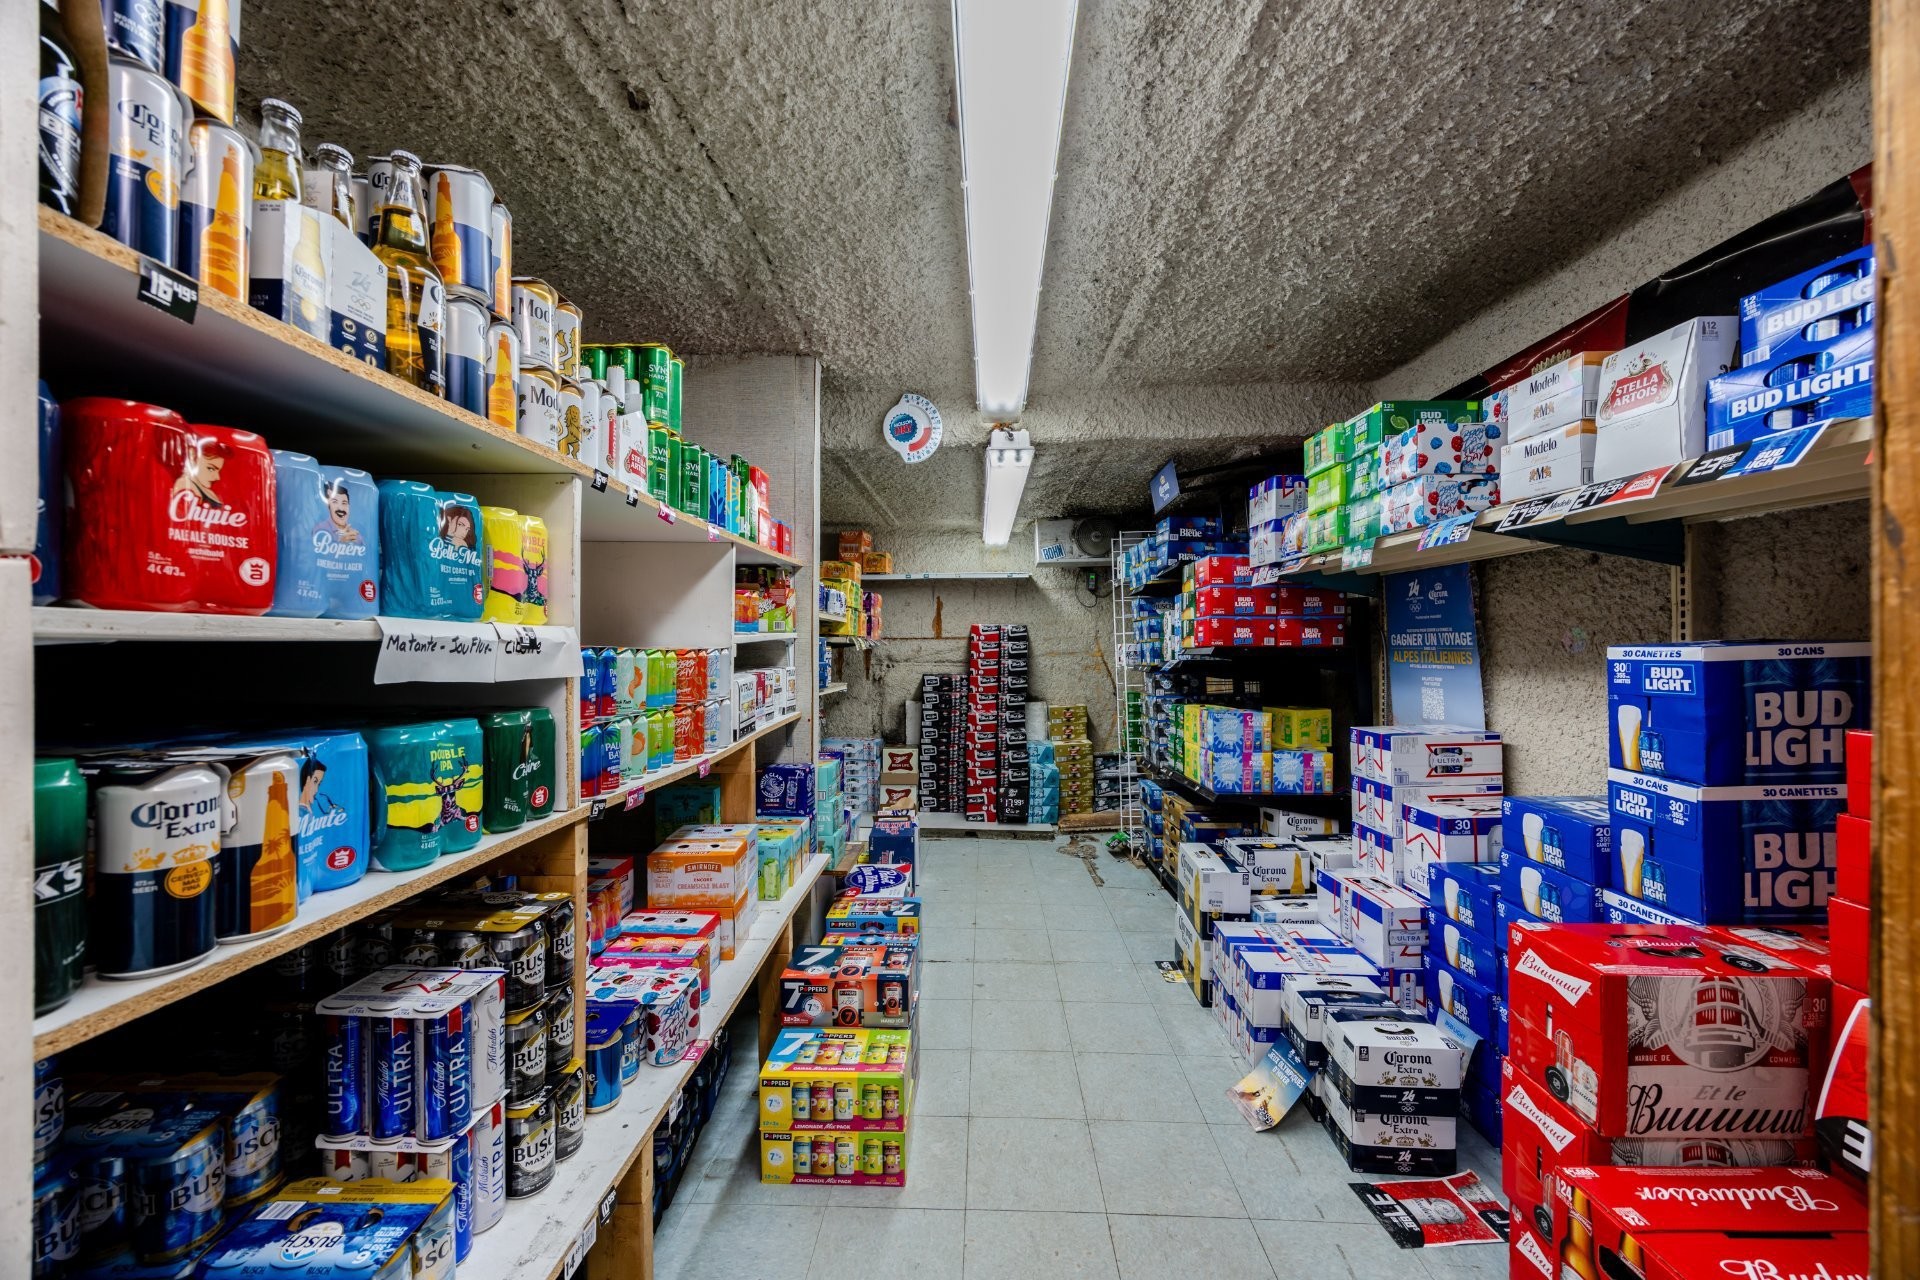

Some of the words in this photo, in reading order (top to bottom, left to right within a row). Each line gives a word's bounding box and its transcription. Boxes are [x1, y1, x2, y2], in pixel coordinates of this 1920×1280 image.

[1743, 295, 1757, 308] 12
[1767, 299, 1822, 332] BUD
[1826, 277, 1875, 306] LIG
[1707, 321, 1717, 330] 12
[1529, 372, 1560, 396] Modelo
[1615, 372, 1659, 398] STELLA
[1732, 388, 1783, 419] BUD
[1786, 359, 1875, 403] LIGHT
[1613, 386, 1658, 409] ARTOIS
[1420, 411, 1442, 420] BUD
[1524, 438, 1557, 459] Modelo
[1754, 447, 1786, 461] BUD
[1744, 456, 1784, 470] LIGHT
[1425, 475, 1435, 483] 12
[168, 490, 248, 529] Chipie
[168, 527, 188, 541] PALE
[189, 530, 207, 544] ALE
[208, 532, 249, 549] ROUSSE
[1179, 528, 1203, 538] Bleue
[428, 537, 459, 561] Belle
[1042, 543, 1066, 561] BOHN
[1391, 633, 1423, 646] GAGNER
[1424, 632, 1438, 646] UN
[1438, 631, 1474, 646] VOYAGE
[1393, 650, 1419, 663] ALPES
[1421, 650, 1473, 665] ITALIENNES
[1622, 650, 1633, 658] 30
[1634, 649, 1682, 658] CANETTES
[1778, 647, 1792, 657] 30
[1793, 647, 1825, 656] CANS
[1613, 662, 1626, 673] 30
[1650, 666, 1684, 680] BUD
[1645, 678, 1692, 692] LIGHT
[1754, 689, 1853, 728] BUD
[430, 747, 465, 762] DOUBLE
[1745, 728, 1845, 766] LIGH
[1641, 749, 1662, 761] BUD
[439, 759, 453, 772] IPA
[1641, 758, 1665, 771] LIGHT
[1633, 777, 1644, 787] 30
[1645, 779, 1669, 793] CANS
[1762, 788, 1776, 797] 30
[1778, 787, 1839, 797] CANETTES
[1620, 789, 1648, 807] BUD
[1616, 799, 1653, 820] LIGHT
[1669, 800, 1684, 813] 30
[1286, 816, 1319, 827] Corona
[1295, 824, 1313, 832] Extra
[1454, 819, 1471, 831] 30
[165, 820, 216, 839] Extra
[1595, 827, 1611, 837] 20
[1544, 843, 1563, 858] BUD
[686, 864, 720, 872] SMIRNOFF
[1252, 865, 1288, 876] Corona
[1261, 874, 1280, 883] Extra
[1644, 878, 1665, 893] BUD
[1744, 870, 1838, 908] LIGH
[1541, 900, 1561, 914] BUD
[1618, 899, 1629, 909] 30
[1459, 905, 1473, 919] BUD
[1610, 908, 1622, 920] 30
[1396, 934, 1421, 942] ULTRA
[797, 947, 836, 966] 7
[1460, 953, 1475, 967] BUD
[513, 953, 545, 977] BUS
[784, 982, 805, 1009] 7
[1454, 1000, 1468, 1015] BUD
[1812, 997, 1828, 1012] 30
[844, 1011, 853, 1022] 7
[1452, 1025, 1467, 1040] LIGHT
[487, 1027, 497, 1075] Michelob
[776, 1032, 815, 1056] 7
[1360, 1047, 1367, 1055] 12
[514, 1040, 546, 1069] BUS
[1383, 1050, 1433, 1067] Corona
[1659, 1054, 1671, 1062] DE
[1769, 1056, 1801, 1064] COMMER
[449, 1037, 466, 1115] ULTRA
[1267, 1051, 1280, 1064] JEUX
[1277, 1060, 1306, 1089] OLYMPIQUES
[1397, 1064, 1423, 1075] Extra
[327, 1043, 343, 1115] ULTRA
[378, 1060, 389, 1110] Michelob
[393, 1039, 412, 1116] ULTRA
[432, 1060, 447, 1111] Michelob
[1695, 1085, 1723, 1101] Et
[1724, 1084, 1746, 1102] le
[1379, 1113, 1430, 1127] Corona
[1393, 1124, 1419, 1135] Extra
[513, 1132, 555, 1163] BUSC
[492, 1131, 504, 1203] ULTRA
[525, 1154, 545, 1167] MAX
[476, 1155, 489, 1203] Michelob
[1635, 1183, 1840, 1212] Budweiser
[456, 1182, 468, 1233] Michelob
[281, 1234, 344, 1248] BUSCH
[240, 1265, 267, 1275] BUSCH
[305, 1265, 332, 1275] BUSCH
